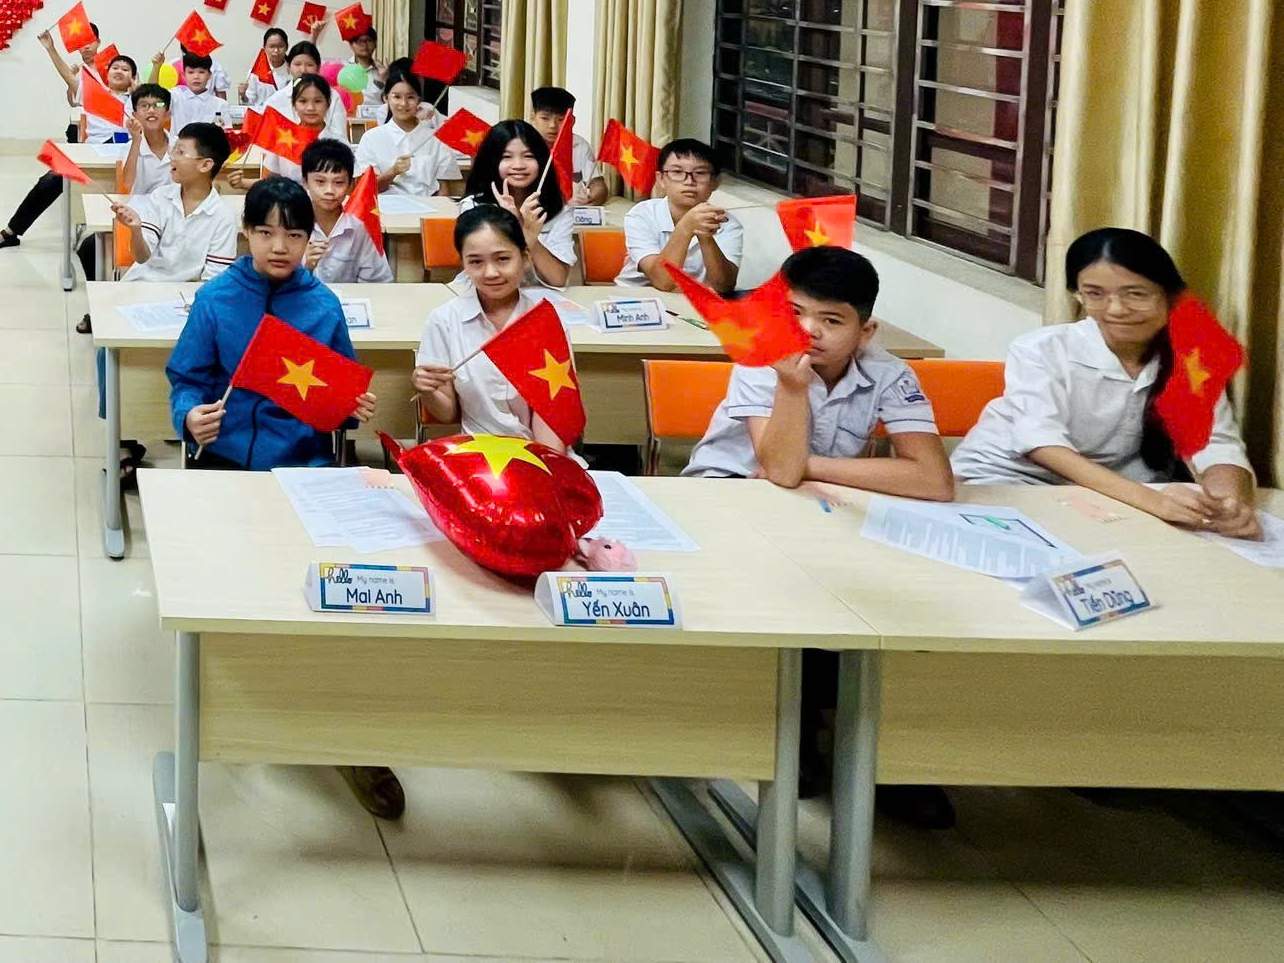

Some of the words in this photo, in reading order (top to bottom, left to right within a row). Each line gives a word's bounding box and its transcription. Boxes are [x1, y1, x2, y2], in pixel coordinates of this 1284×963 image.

[324, 567, 353, 584] hello
[357, 575, 368, 584] My
[368, 576, 388, 584] name
[388, 576, 394, 584] is
[346, 587, 371, 604] Mai
[375, 589, 403, 605] Anh
[562, 580, 592, 598] hello
[596, 588, 607, 597] My
[582, 599, 610, 618] Yến
[612, 601, 651, 617] Xuân
